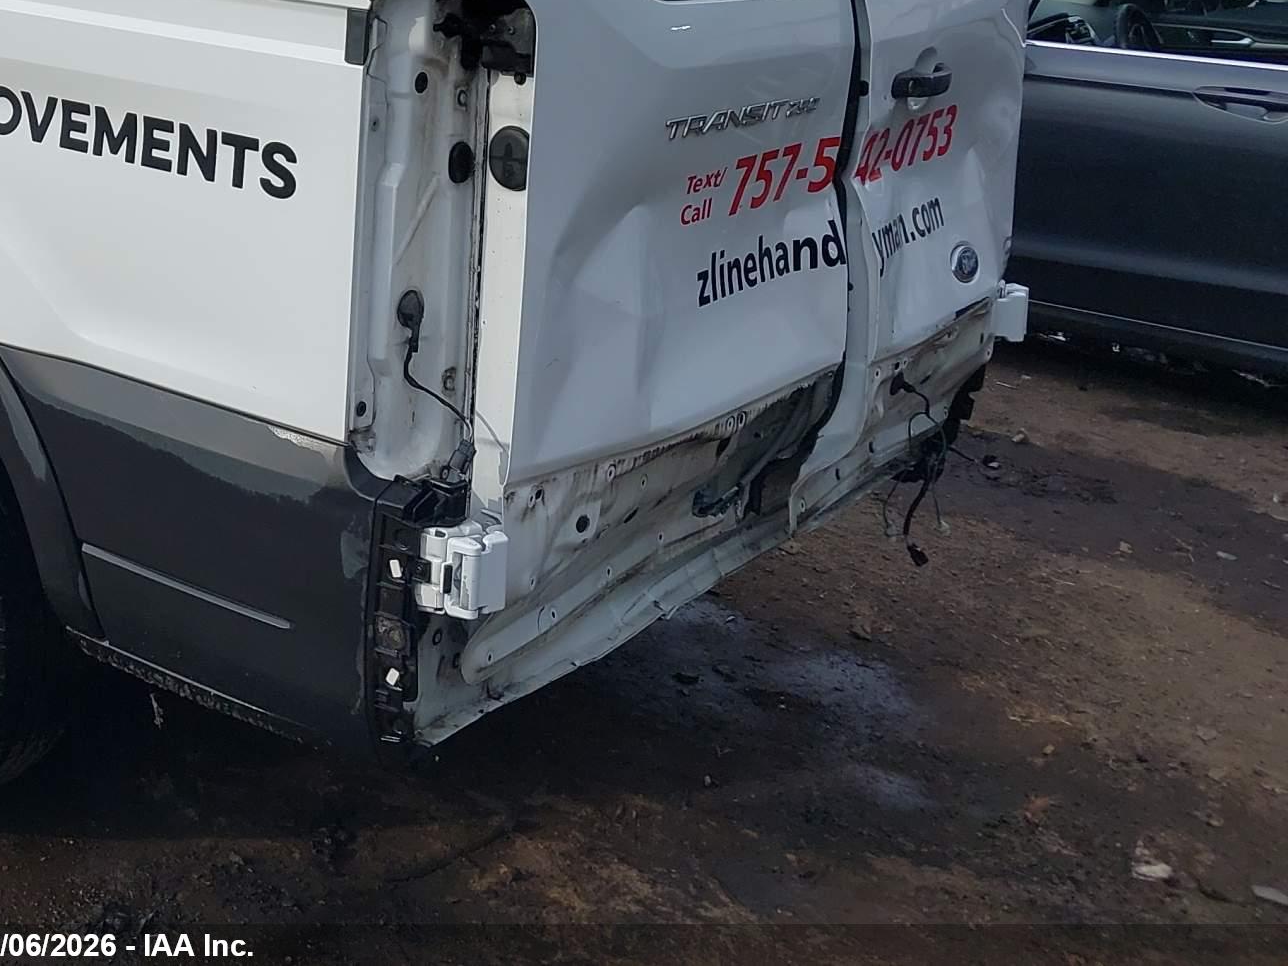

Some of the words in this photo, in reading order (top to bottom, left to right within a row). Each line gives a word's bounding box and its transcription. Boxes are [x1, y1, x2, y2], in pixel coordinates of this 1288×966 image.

[666, 98, 790, 140] TRANSIT
[687, 168, 726, 195] Text/
[680, 198, 712, 226] Call
